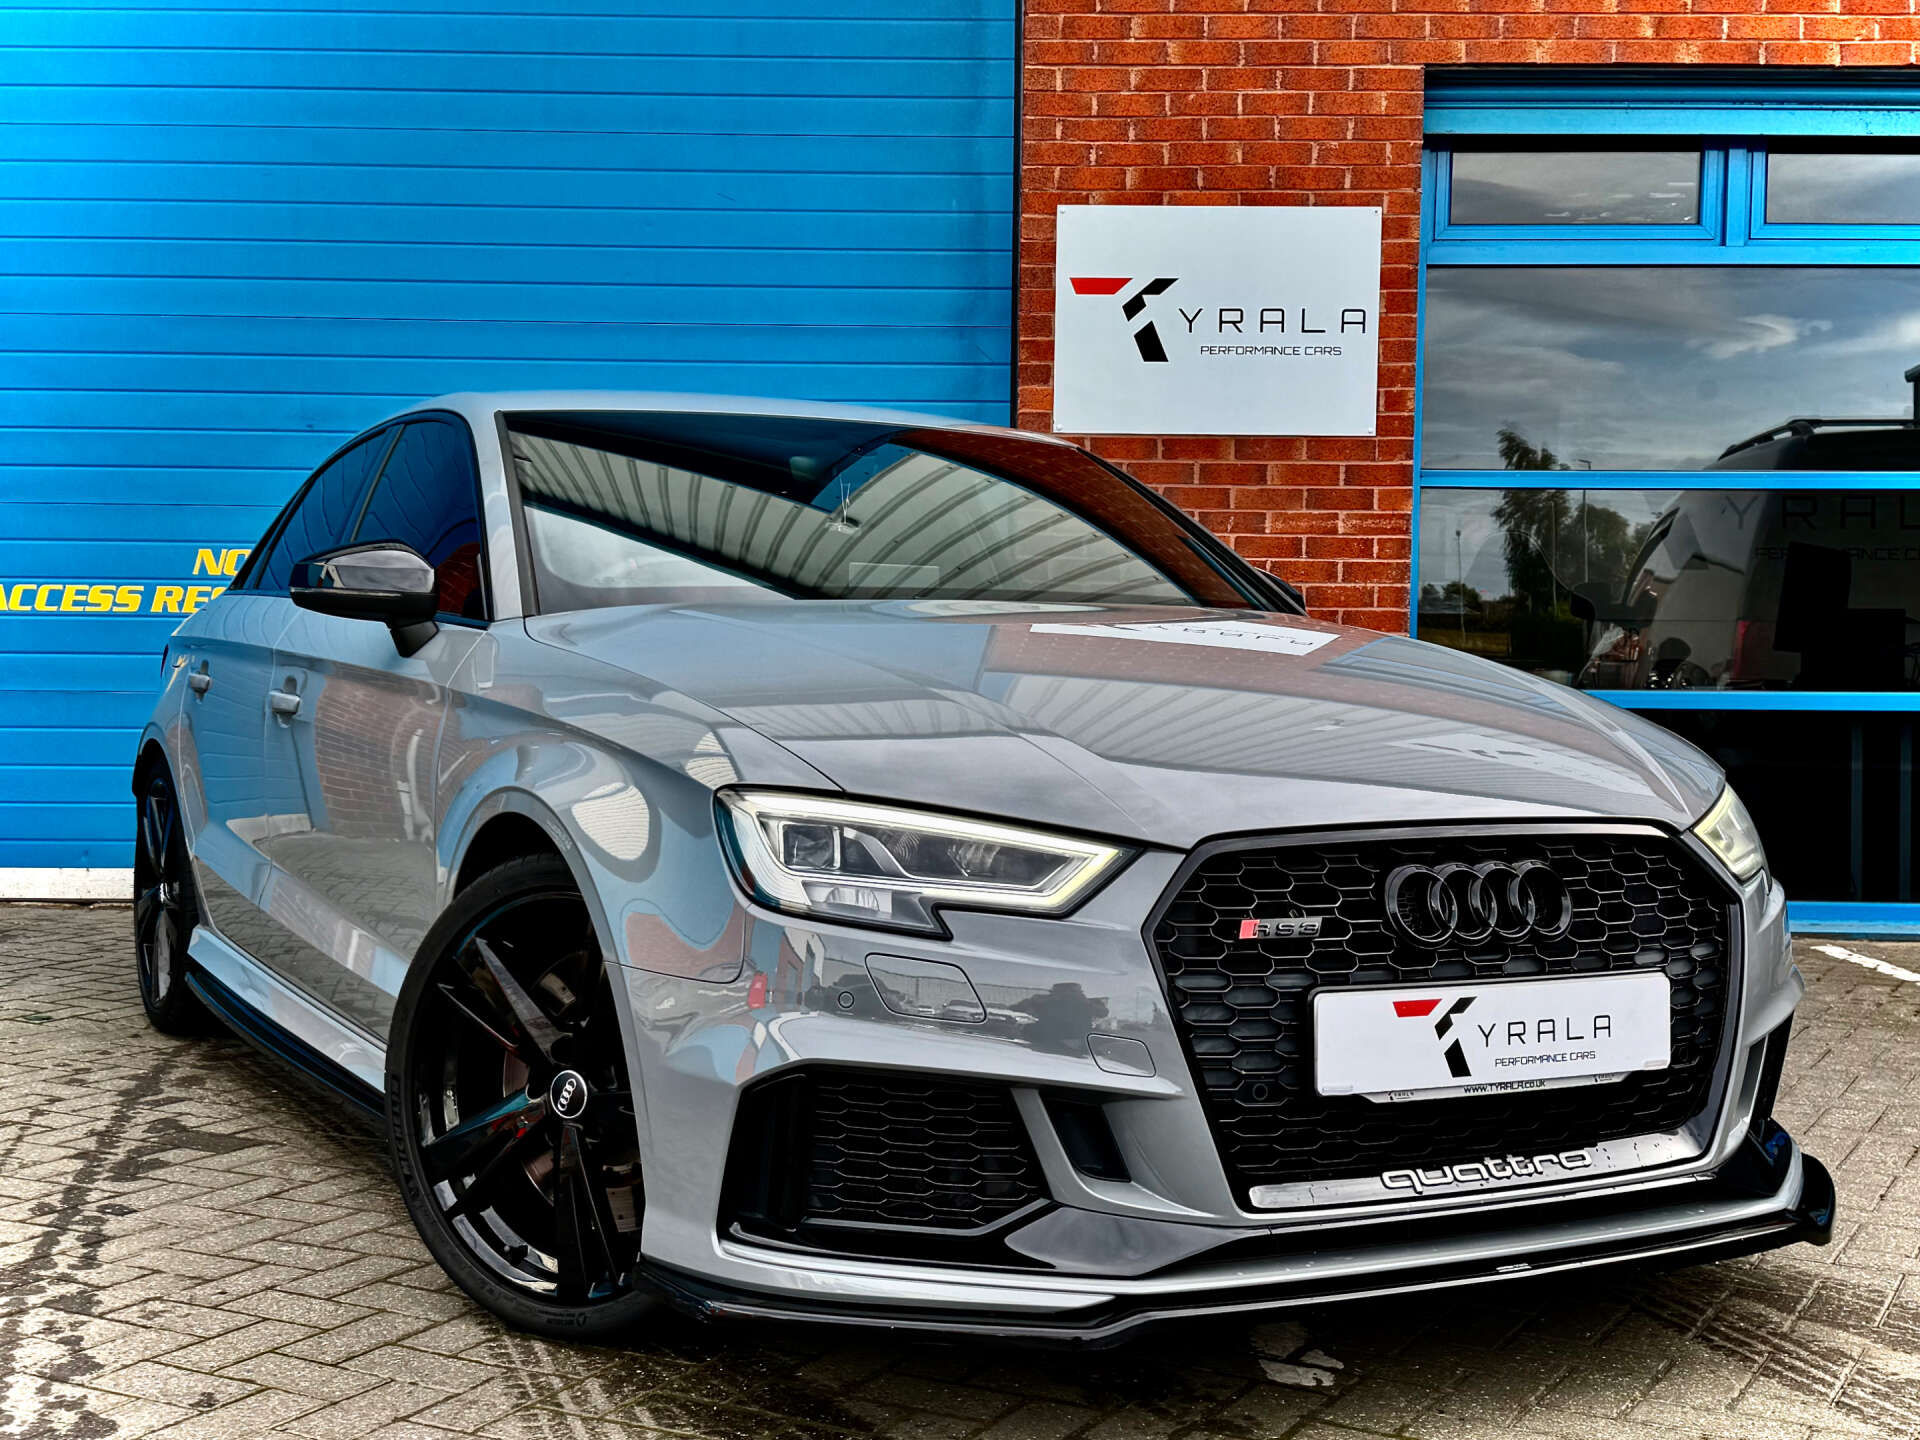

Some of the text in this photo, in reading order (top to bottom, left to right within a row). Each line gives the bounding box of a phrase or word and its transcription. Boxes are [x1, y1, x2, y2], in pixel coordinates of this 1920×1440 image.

[1200, 345, 1342, 356] PERFORMANCE CARS
[1252, 922, 1319, 937] RS3
[1494, 1050, 1596, 1068] PERFORMANCE CARS
[1380, 1149, 1593, 1195] quattro
